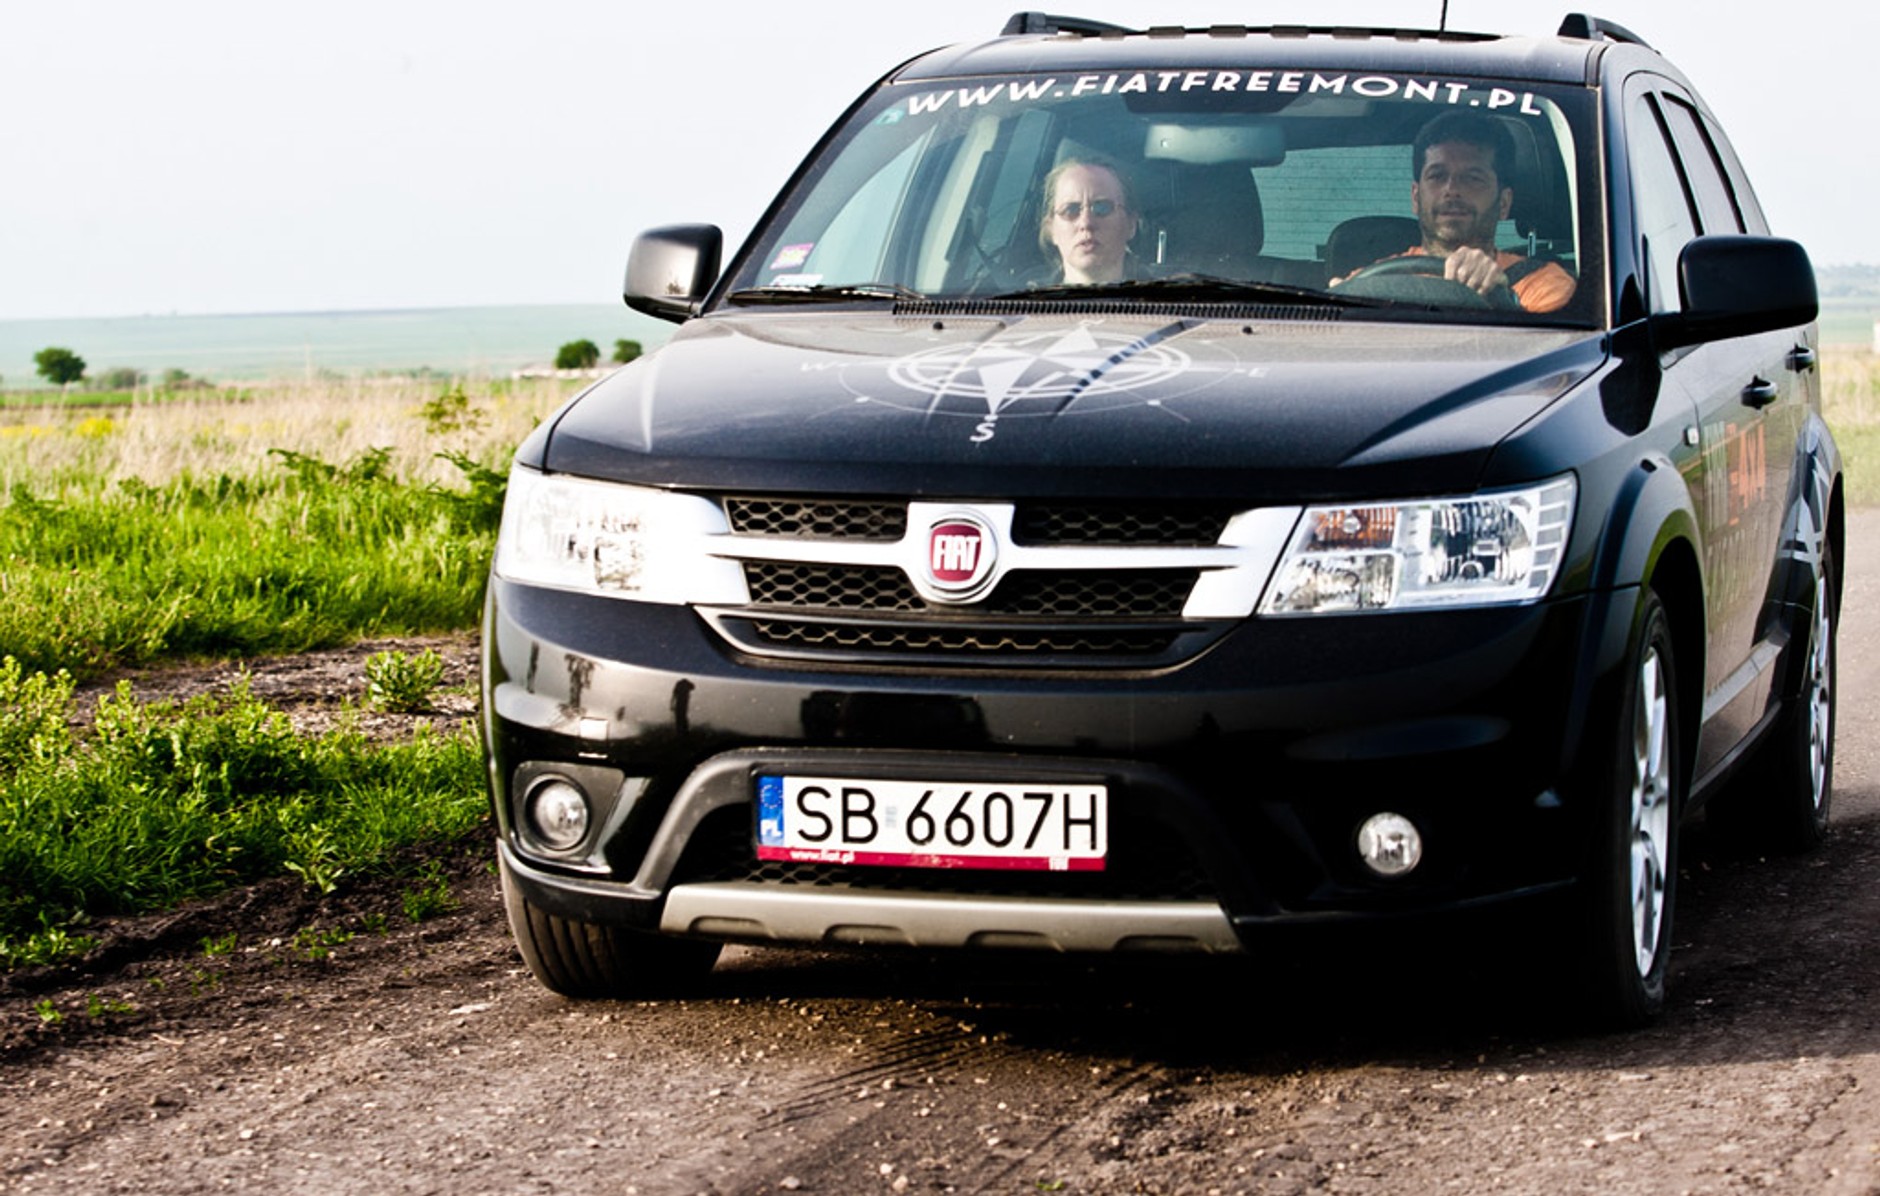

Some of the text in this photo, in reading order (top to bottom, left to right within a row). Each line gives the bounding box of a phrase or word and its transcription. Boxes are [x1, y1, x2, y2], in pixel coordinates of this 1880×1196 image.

[908, 71, 1542, 116] WWW.FIATFREEMONT.PL
[970, 422, 995, 442] S
[932, 534, 981, 571] FIAT
[760, 819, 783, 837] PL
[796, 786, 1098, 851] SB 6607H
